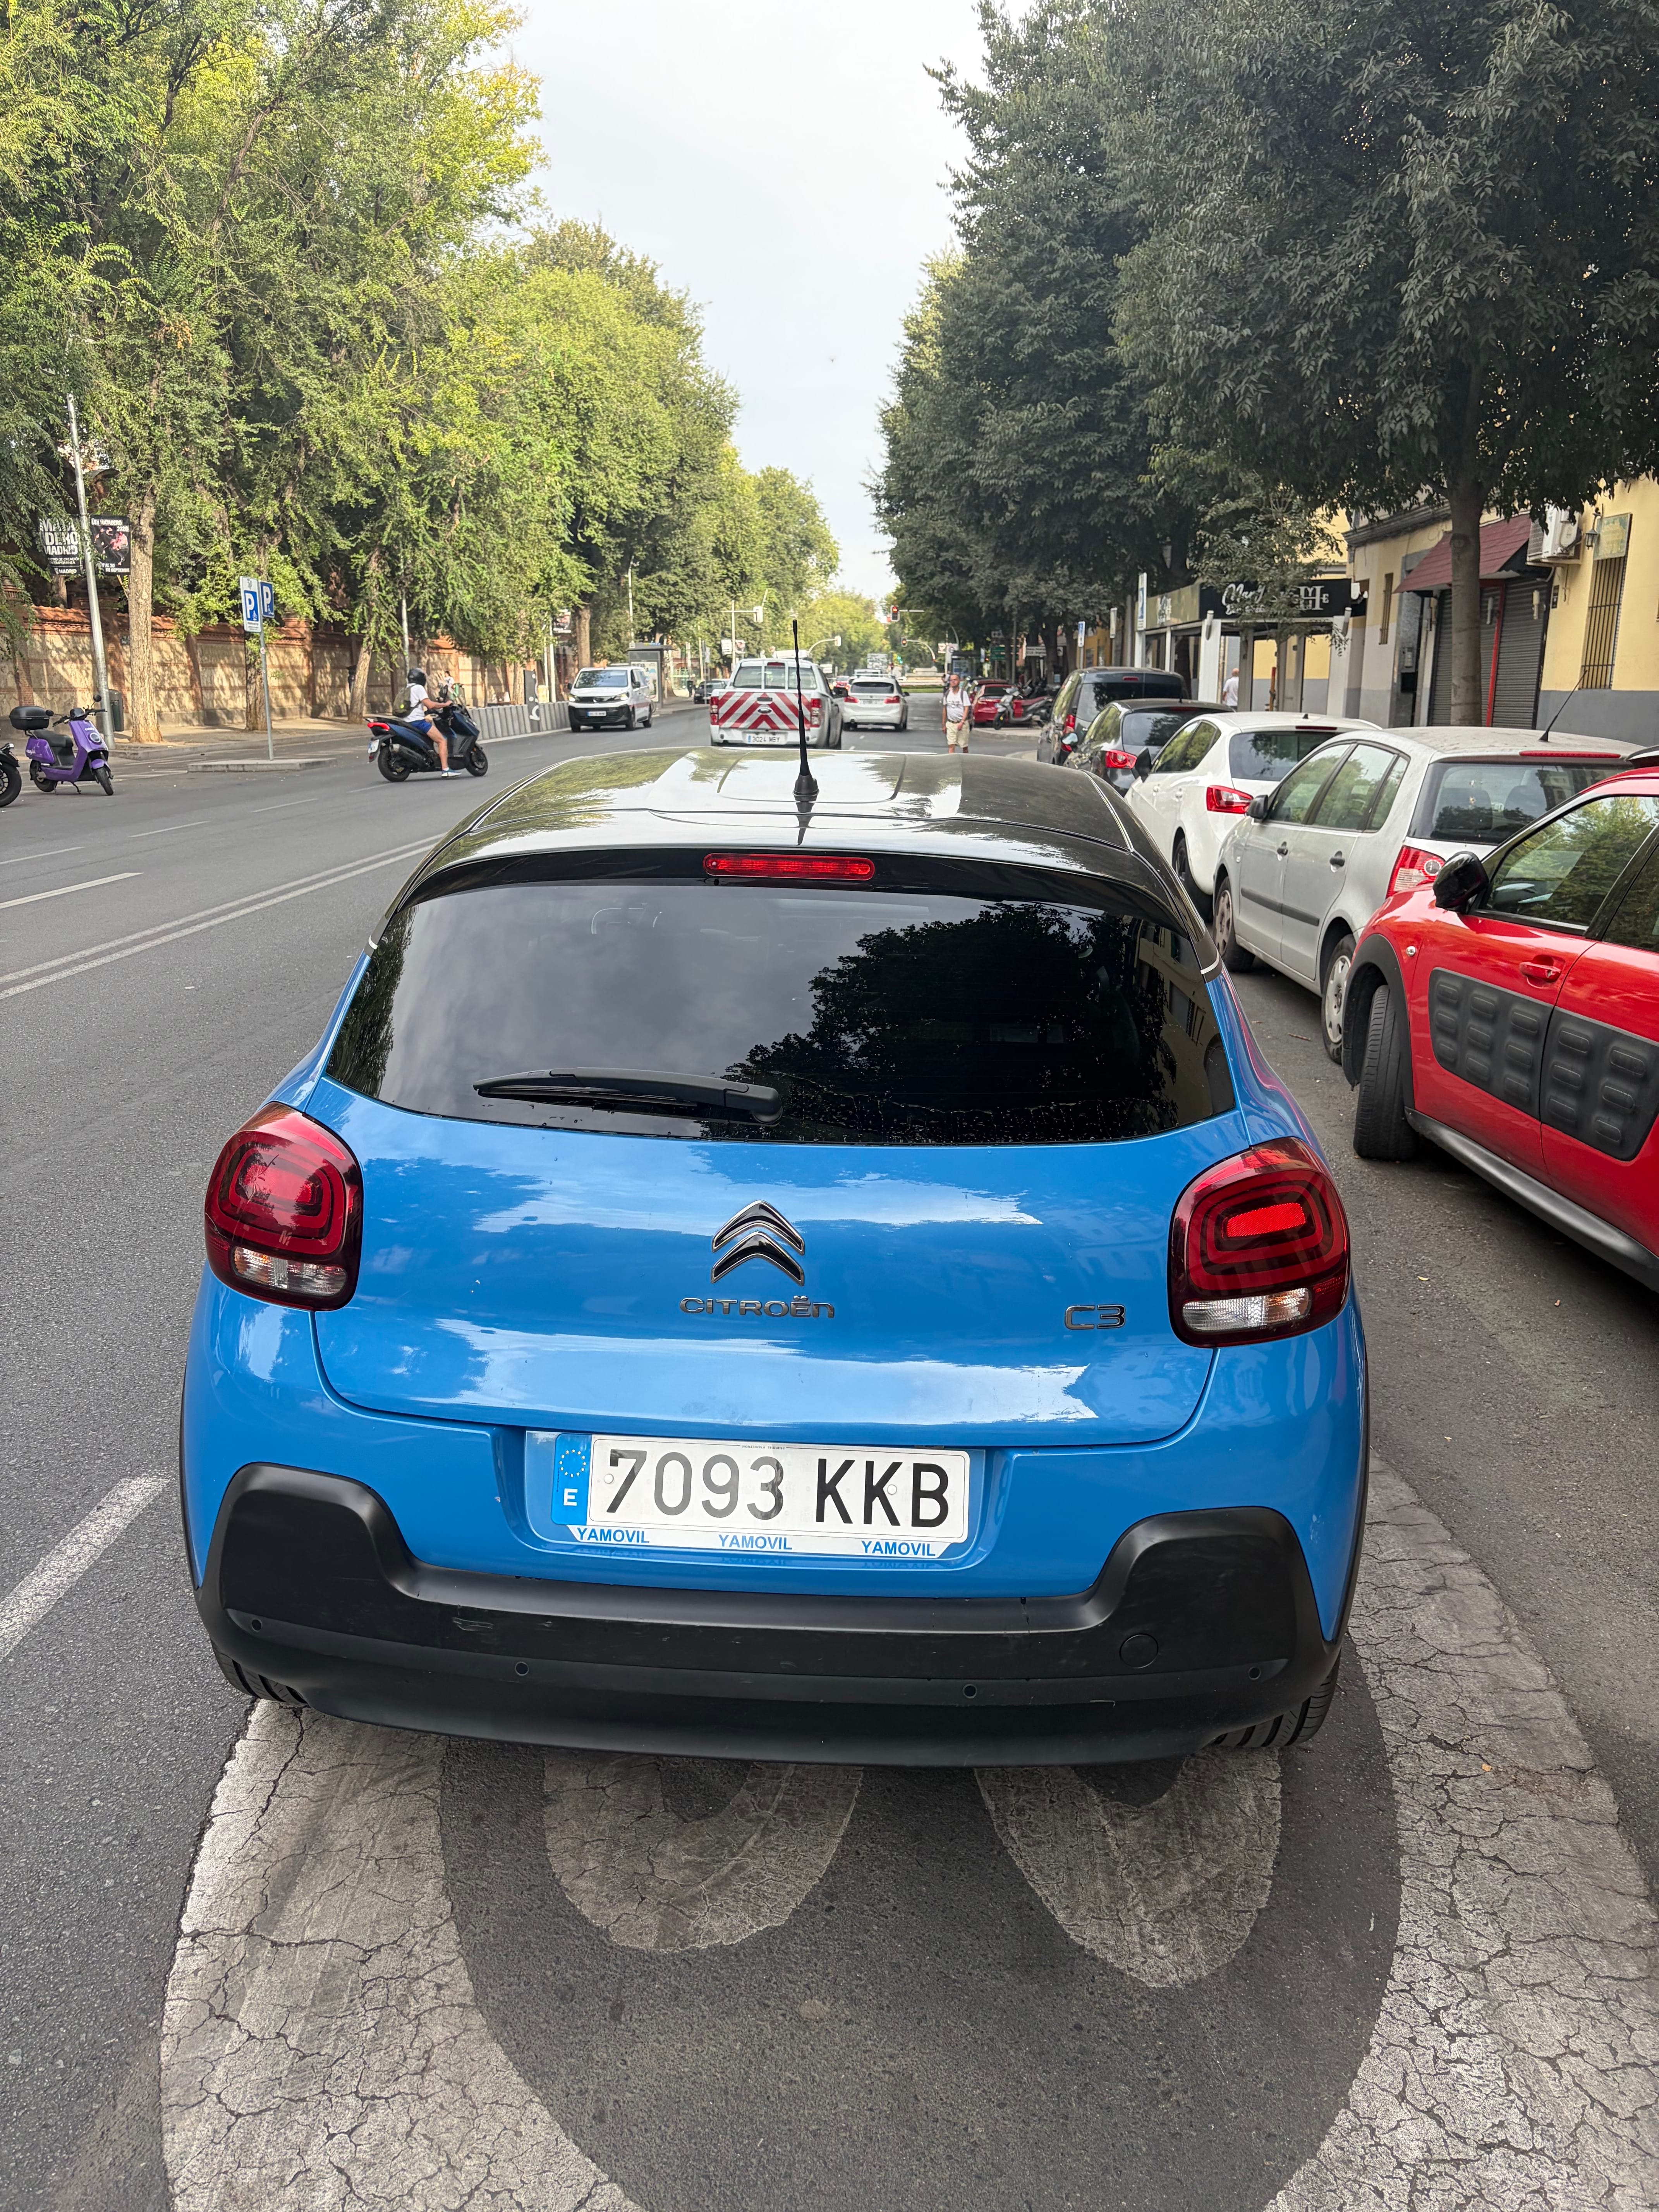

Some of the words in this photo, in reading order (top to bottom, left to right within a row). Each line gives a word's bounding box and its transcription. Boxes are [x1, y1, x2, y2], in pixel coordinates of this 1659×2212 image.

[43, 545, 78, 555] MADRID
[245, 593, 254, 618] P
[263, 586, 271, 612] P
[1065, 1304, 1125, 1330] C3
[563, 1488, 578, 1506] E
[606, 1449, 784, 1520] 7093
[816, 1458, 949, 1527] KKB
[577, 1527, 649, 1543] YAMOVIL
[719, 1534, 792, 1550] YAMOVIL
[861, 1540, 936, 1556] YAMOVIL
